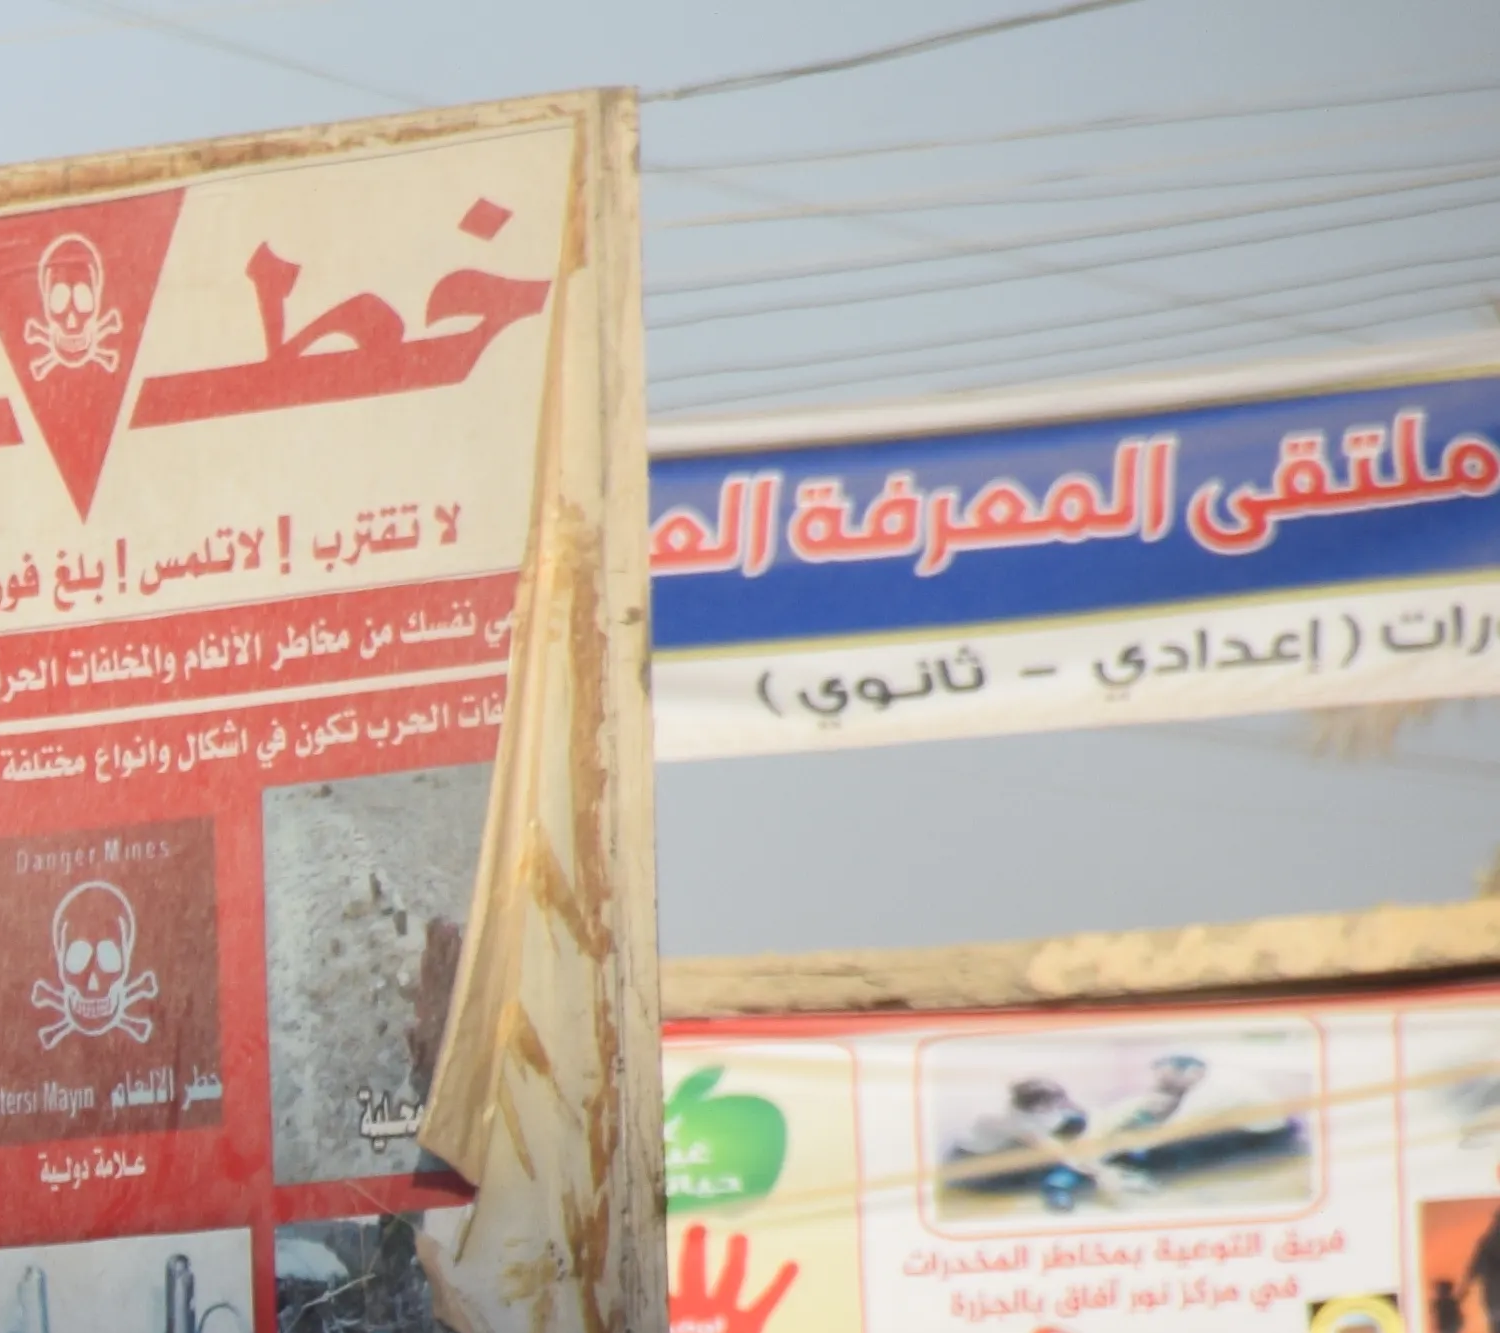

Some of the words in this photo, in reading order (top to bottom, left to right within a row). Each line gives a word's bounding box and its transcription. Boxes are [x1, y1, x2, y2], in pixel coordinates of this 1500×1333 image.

[1190, 408, 1500, 556] ملتقى
[434, 503, 461, 545] لا
[788, 436, 1178, 577] المعرفة
[312, 504, 420, 573] تقترب
[52, 549, 105, 612] بلغ
[360, 621, 394, 660] من
[400, 603, 478, 645] نفسك
[64, 643, 178, 690] والمخلفات
[270, 624, 352, 672] مخاطر
[255, 723, 288, 770] في
[299, 712, 358, 758] تكون
[366, 700, 451, 750] الحرب
[94, 738, 170, 785] وانواع
[16, 848, 96, 874] Danger
[182, 1065, 223, 1111] خطر
[39, 1153, 90, 1191] دولية
[94, 1149, 146, 1178] علامة
[902, 1244, 1029, 1281] المخدرات
[1153, 1231, 1263, 1269] التوعية
[1273, 1228, 1346, 1262] فريق
[1182, 1277, 1240, 1311] مركز
[1250, 1275, 1300, 1310] في
